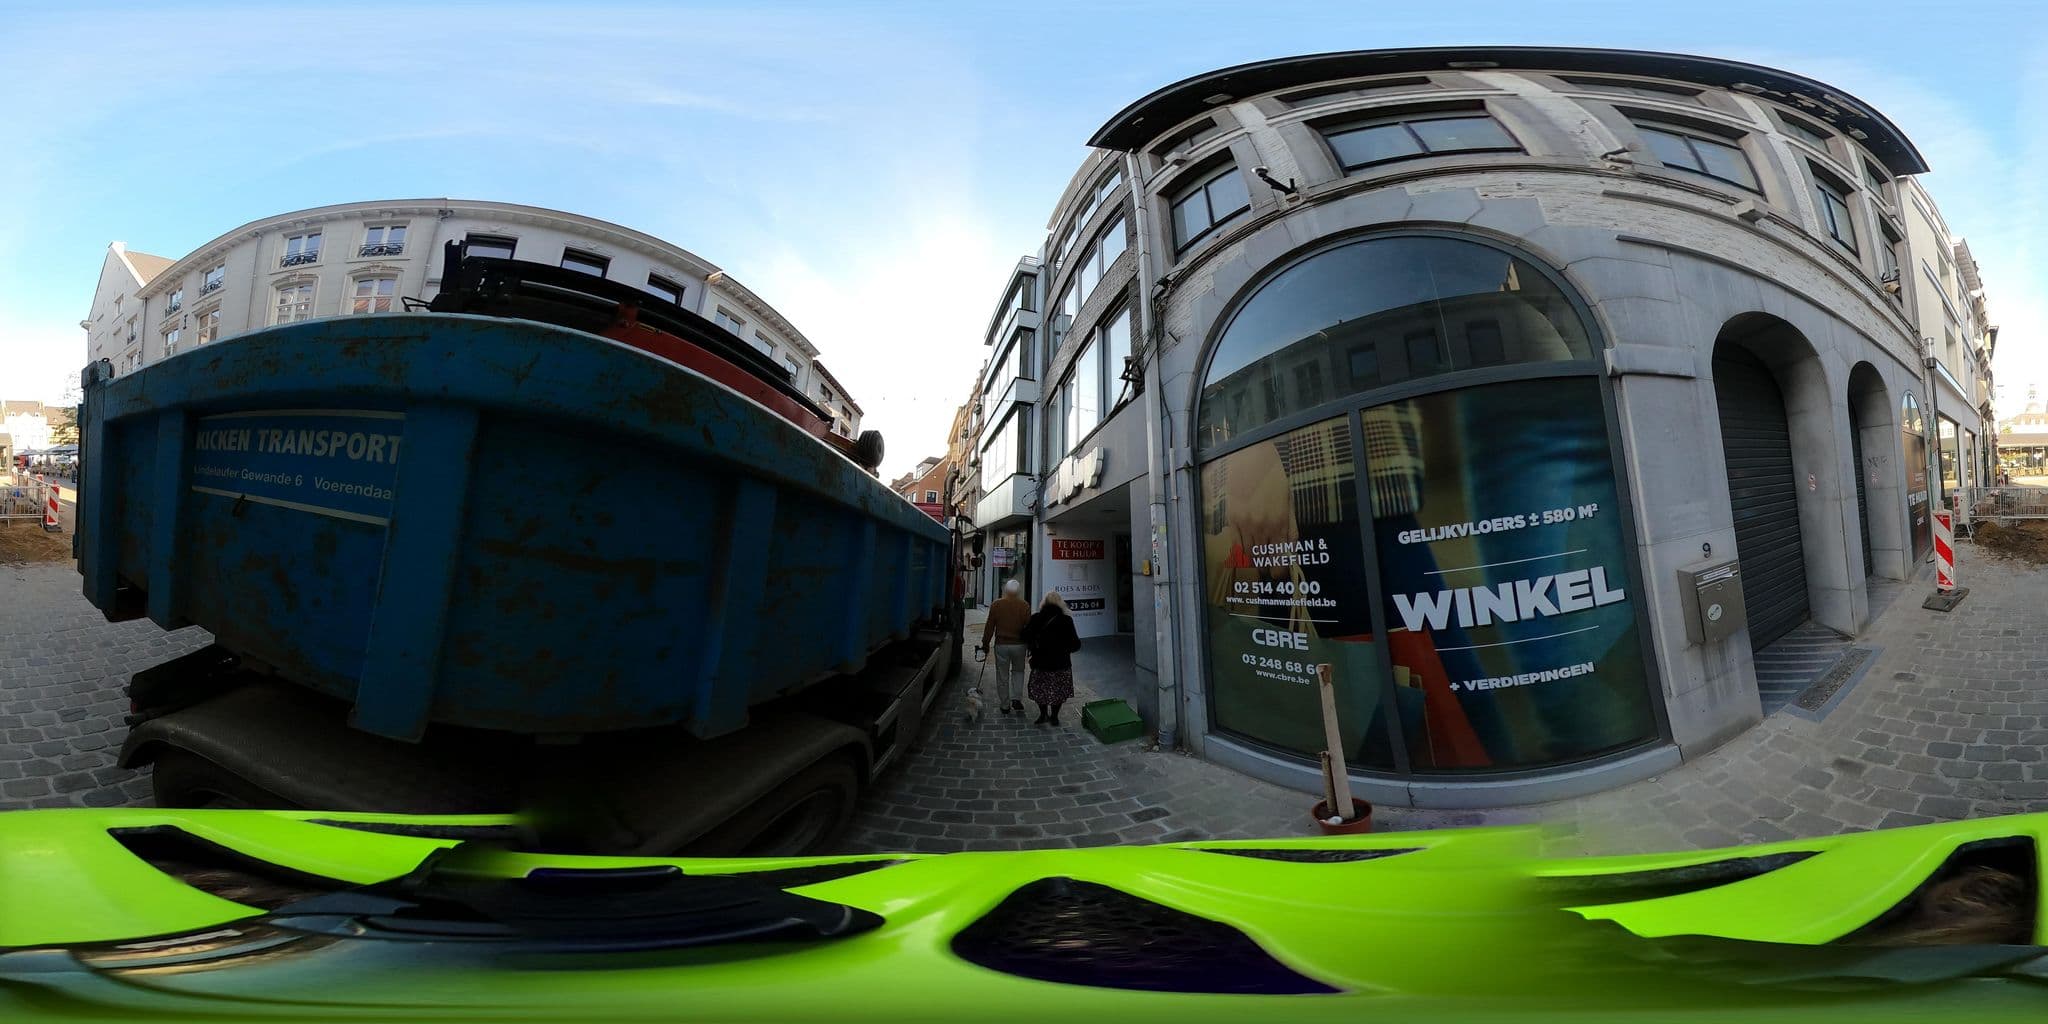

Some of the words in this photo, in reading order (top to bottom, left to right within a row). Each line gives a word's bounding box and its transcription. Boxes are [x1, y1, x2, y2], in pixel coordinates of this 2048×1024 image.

[196, 430, 250, 451] KICKEN
[257, 429, 403, 465] TRANSPORT
[241, 468, 292, 485] Gewande
[295, 474, 304, 487] 6
[314, 476, 393, 501] Voerendaa
[1398, 514, 1526, 545] GELIJKVLOERS
[1528, 512, 1540, 527] ±
[1543, 507, 1576, 525] 580
[1577, 503, 1599, 519] M²
[1056, 540, 1067, 549] TE
[1252, 540, 1314, 555] CUSHMAN
[1318, 538, 1328, 550] &
[1702, 542, 1711, 558] 9
[1059, 549, 1070, 558] TE
[1253, 552, 1330, 568] WAKEFIELD
[1234, 581, 1249, 593] 02
[1251, 581, 1273, 594] 514
[1276, 581, 1295, 594] 40
[1299, 581, 1321, 595] 00
[1080, 601, 1090, 609] 26
[1245, 597, 1337, 607] cushmanwakefield.be
[1392, 566, 1625, 632] WINKEL
[1252, 628, 1309, 651] CBRE
[1242, 653, 1257, 666] 03
[1259, 656, 1283, 670] 248
[1285, 660, 1303, 673] 68
[1306, 664, 1318, 675] 6
[1255, 669, 1310, 685] www.cbre.be
[1449, 682, 1460, 692] +
[1463, 661, 1595, 692] VERDIEPINGEN
